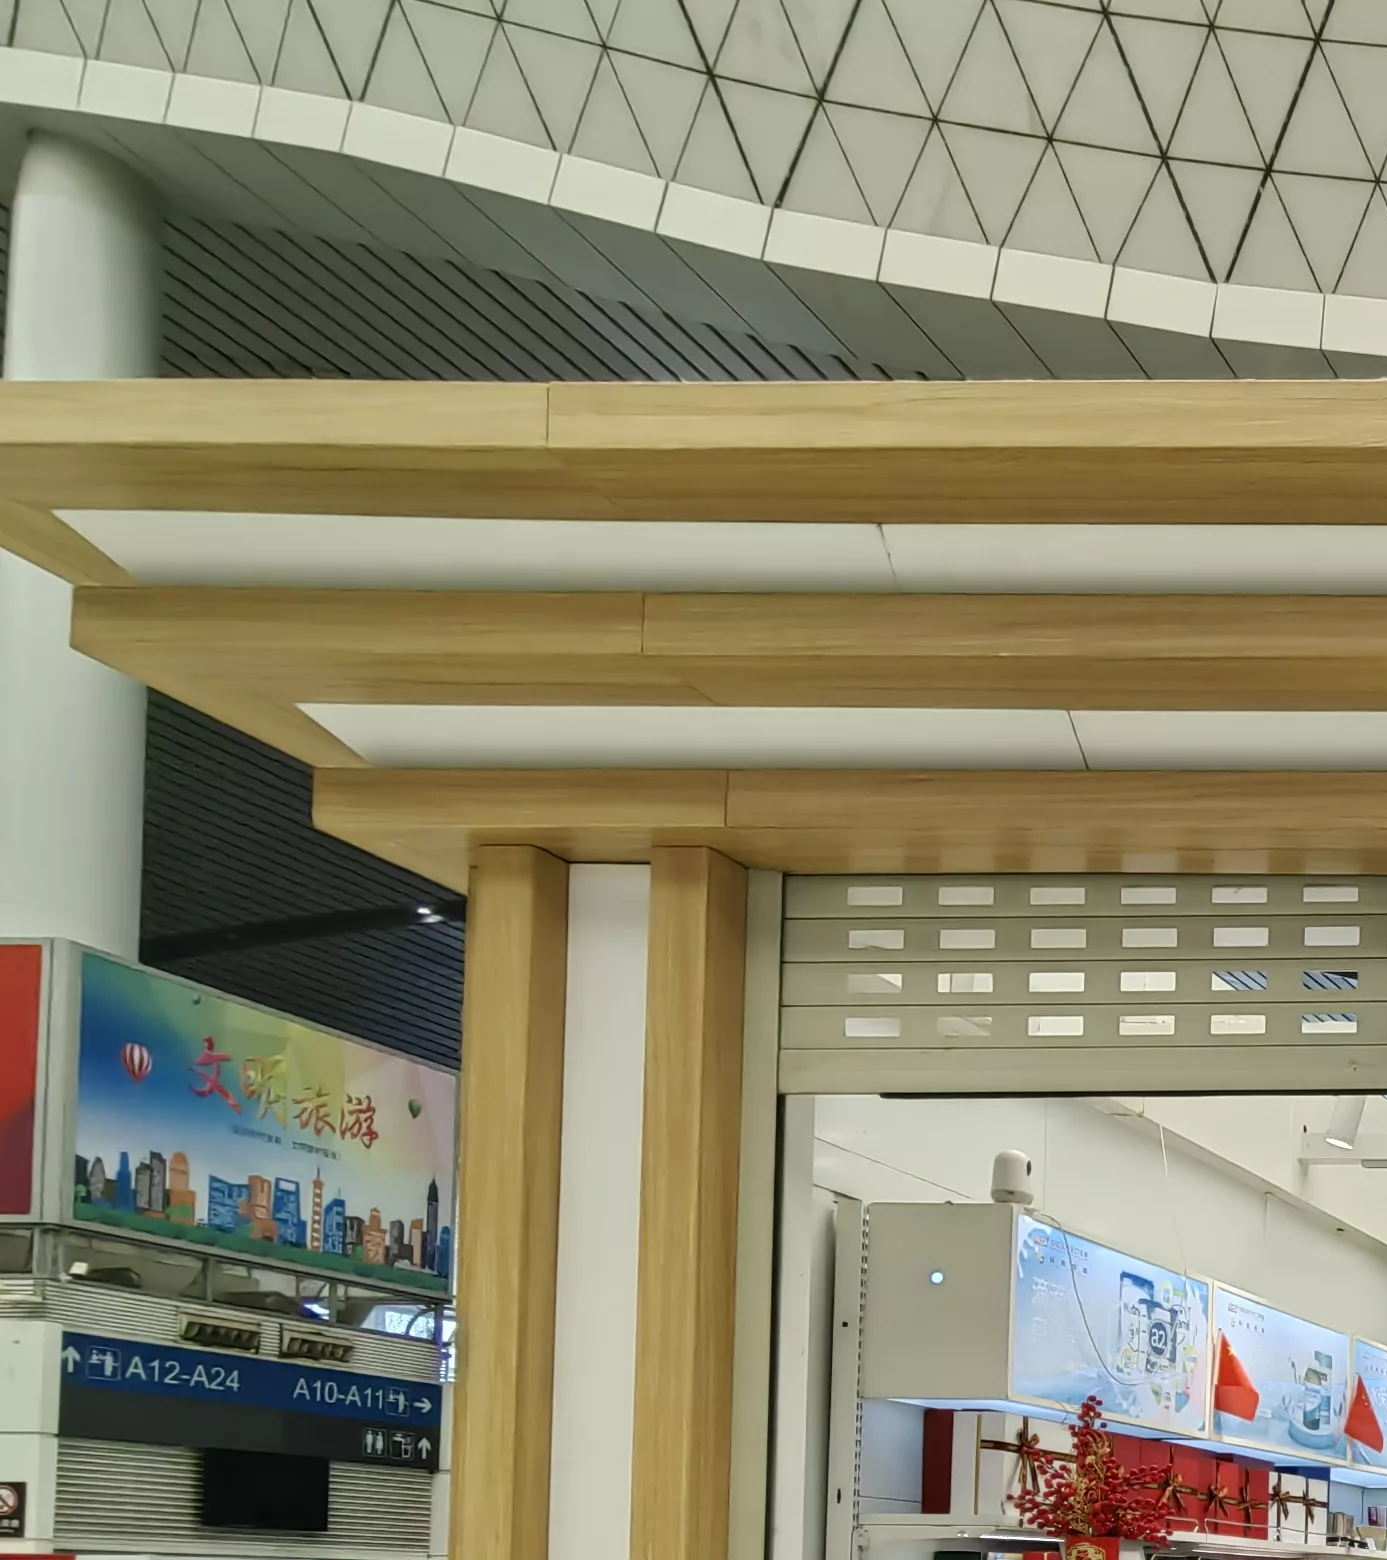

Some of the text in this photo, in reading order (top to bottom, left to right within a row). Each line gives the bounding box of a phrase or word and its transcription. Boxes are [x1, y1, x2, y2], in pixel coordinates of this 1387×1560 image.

[189, 1036, 379, 1149] 文明旅游
[126, 1355, 241, 1391] A12-A24
[293, 1378, 385, 1410] A10-A11
